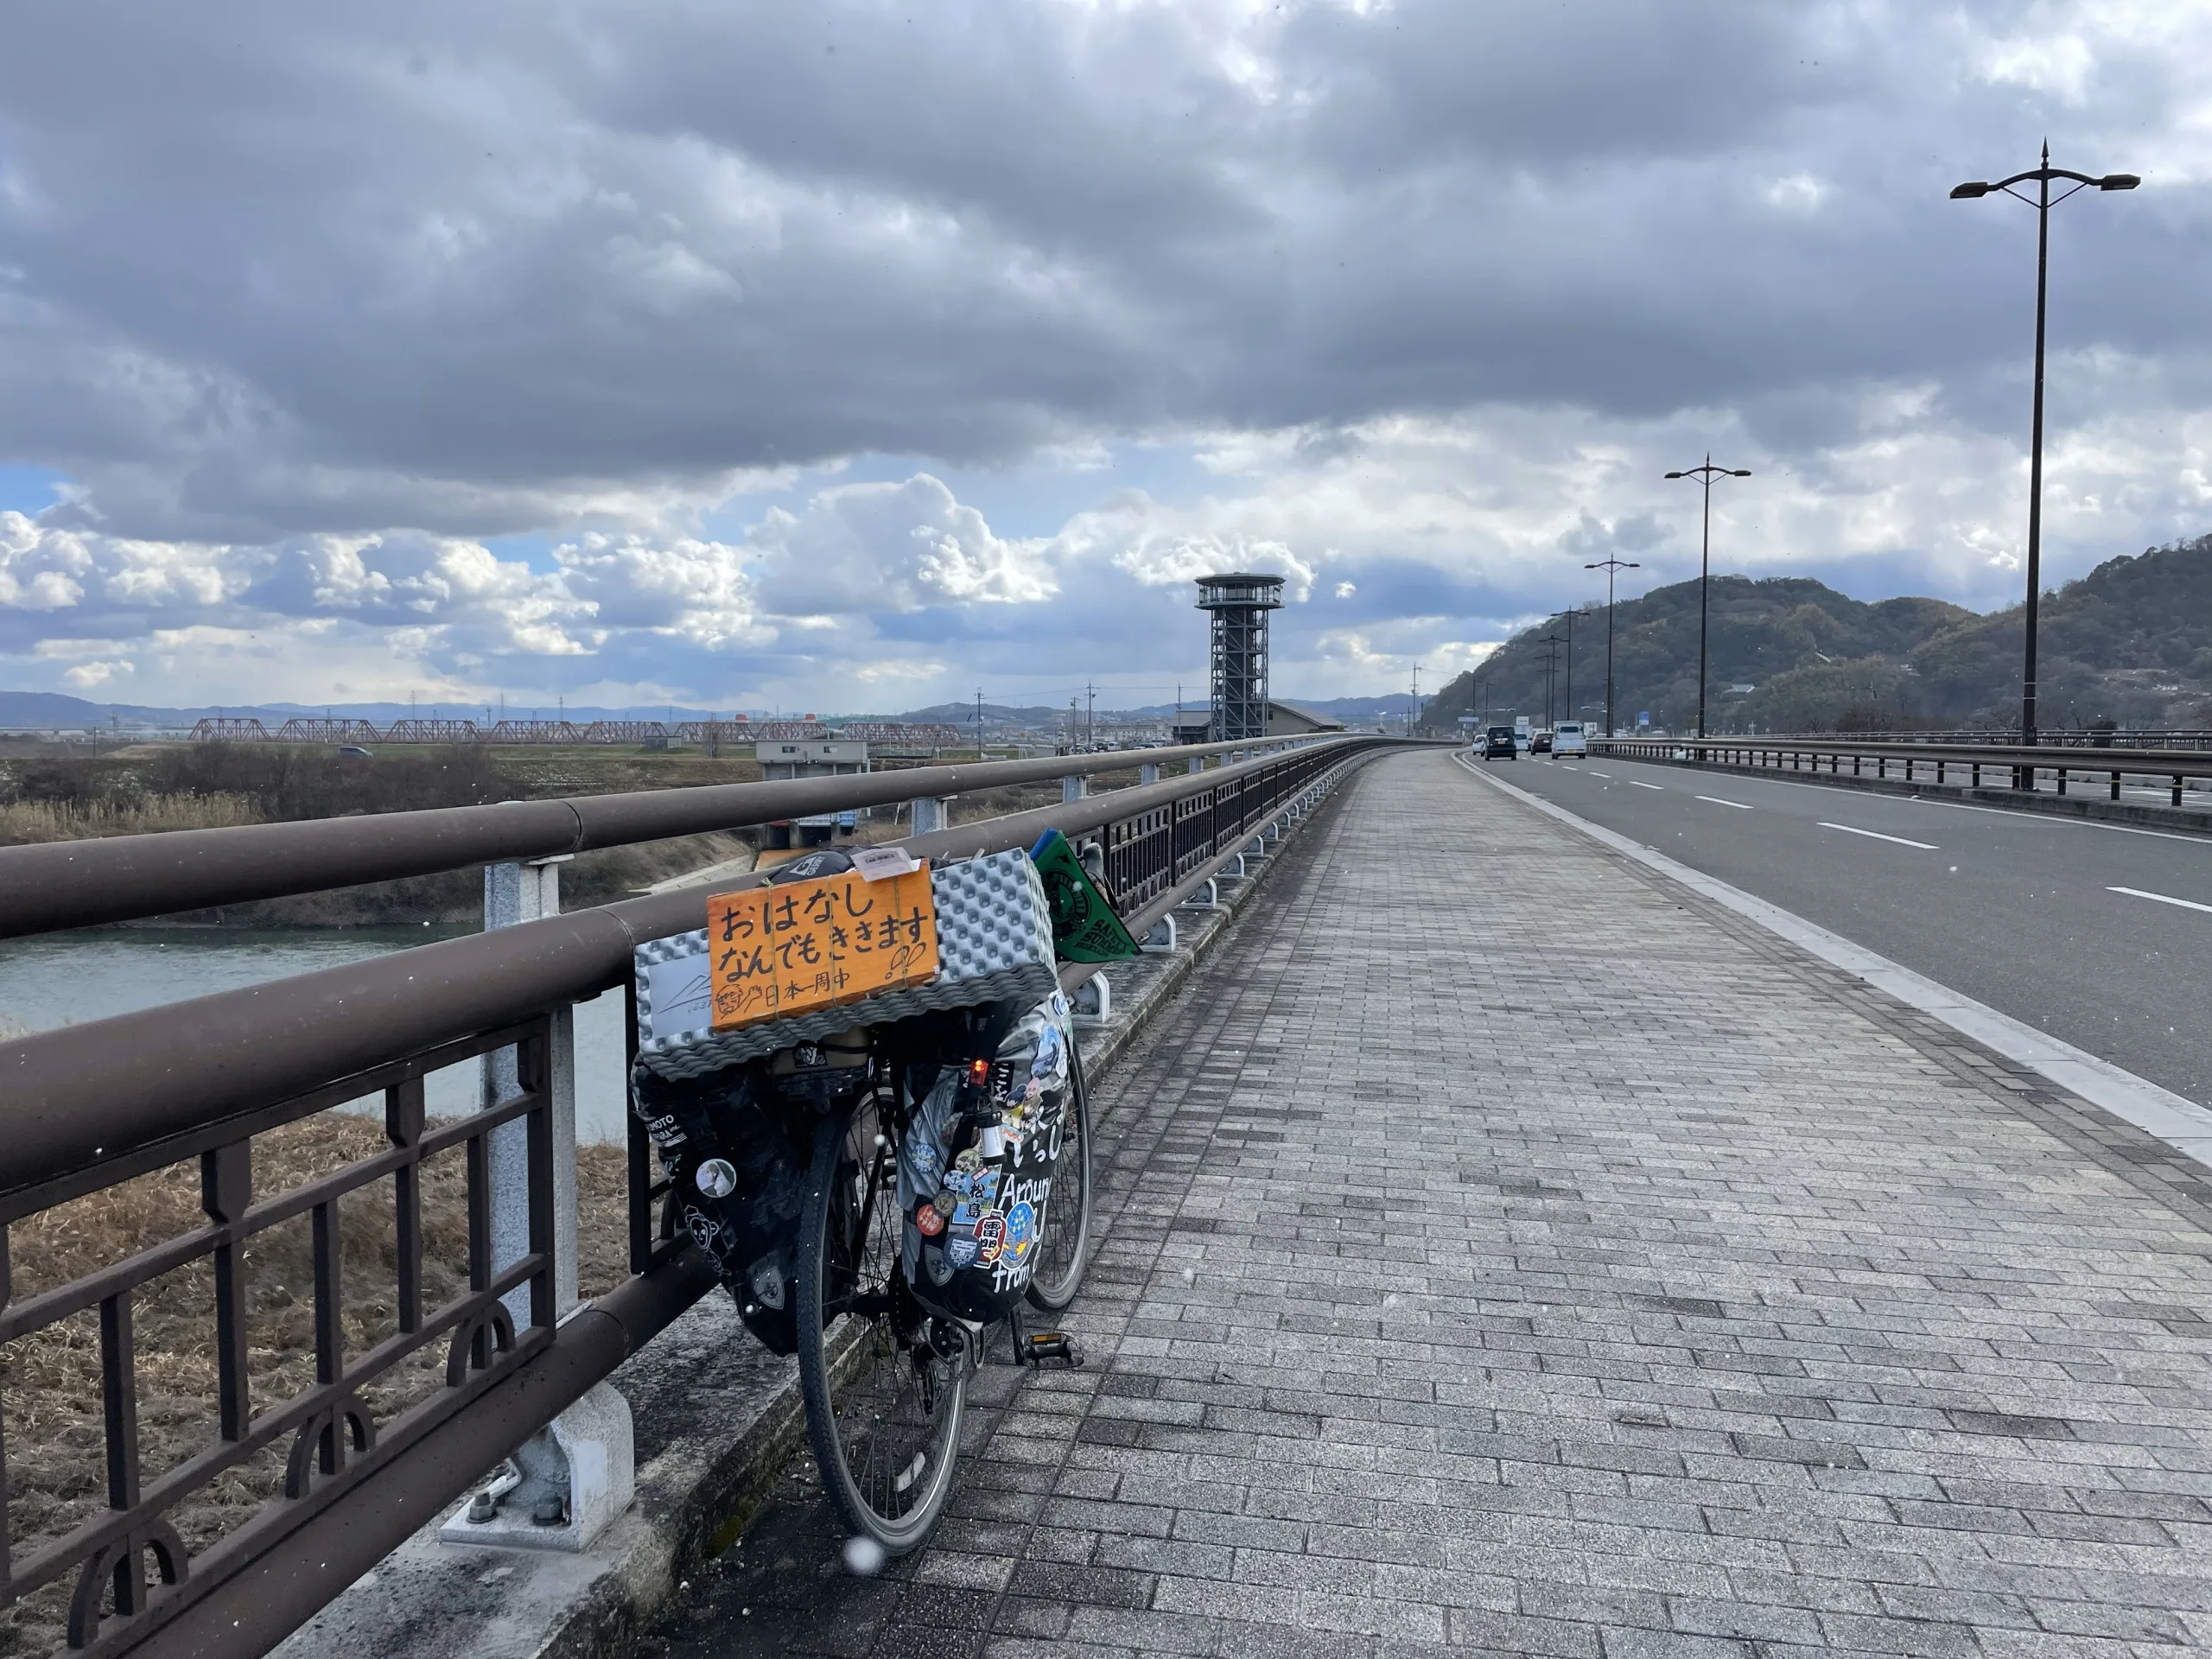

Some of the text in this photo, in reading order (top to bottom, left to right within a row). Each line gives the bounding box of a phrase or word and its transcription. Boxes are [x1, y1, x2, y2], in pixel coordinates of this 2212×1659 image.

[722, 883, 874, 942] おはなし
[1091, 919, 1128, 947] SAFETY
[766, 968, 850, 1007] 日本一周中
[649, 1115, 674, 1131] MOTO
[966, 1182, 986, 1219] 松島
[992, 1260, 1030, 1294] from
